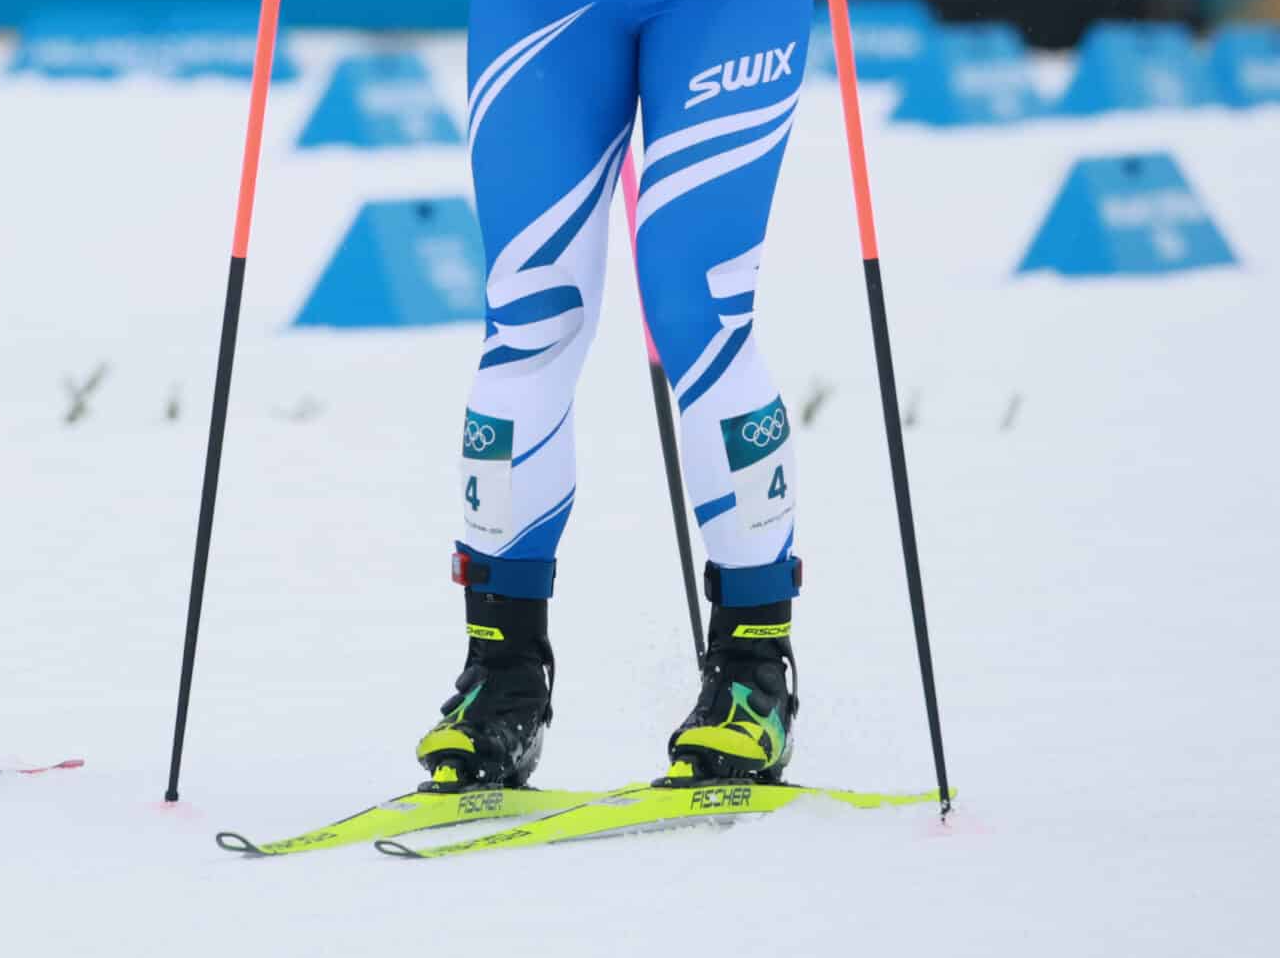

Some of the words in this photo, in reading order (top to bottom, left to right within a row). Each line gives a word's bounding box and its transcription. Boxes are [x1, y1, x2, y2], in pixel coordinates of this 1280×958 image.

[684, 41, 797, 110] SWIX
[465, 475, 480, 511] 4
[768, 464, 787, 499] 4
[691, 788, 751, 810] FISCHER
